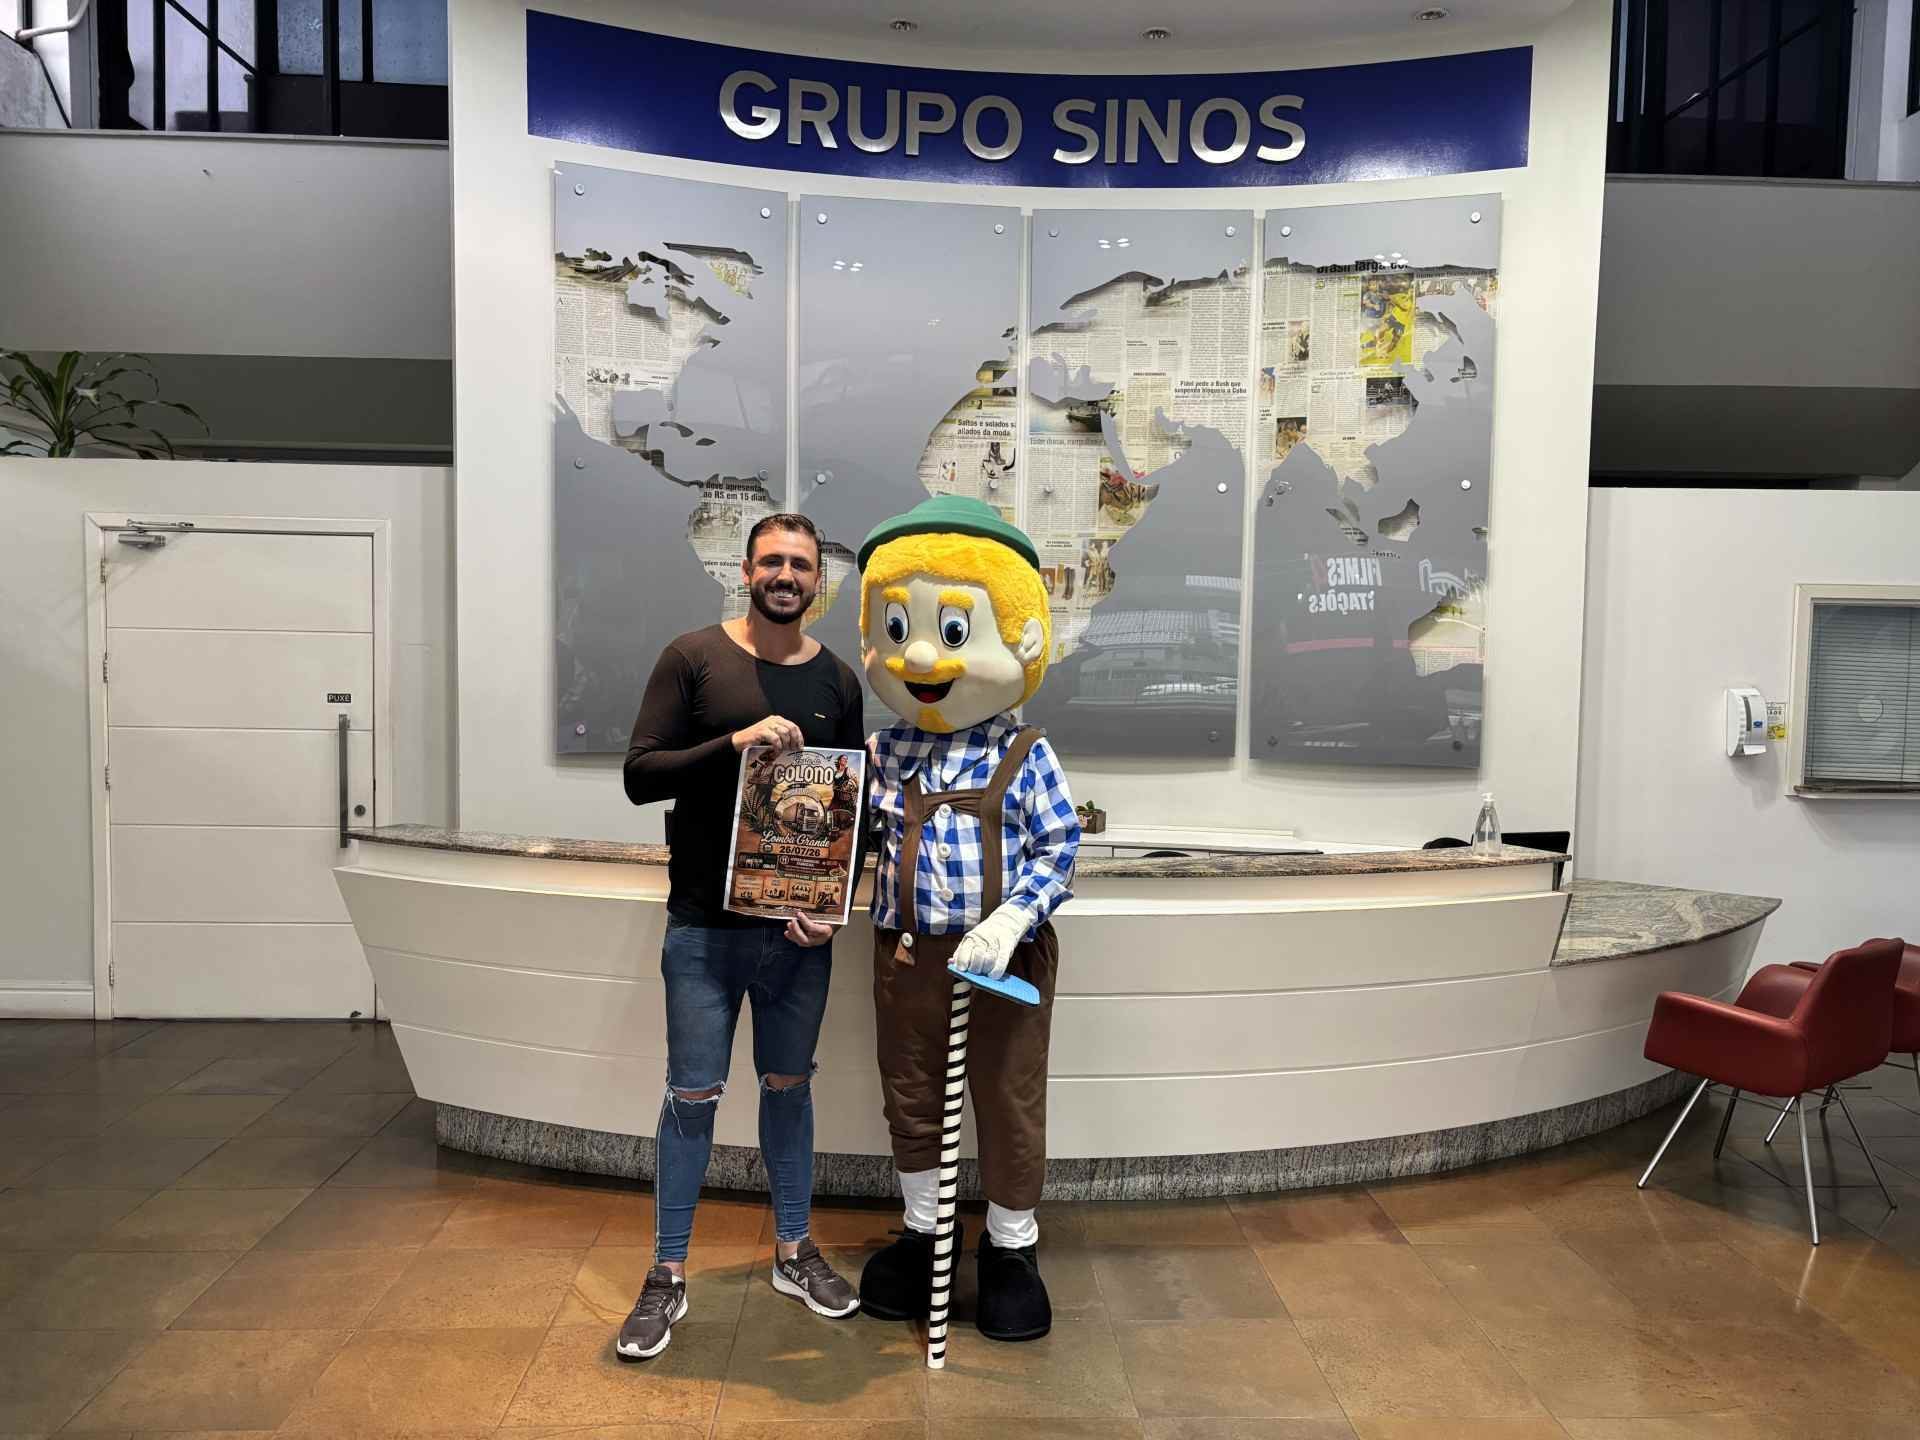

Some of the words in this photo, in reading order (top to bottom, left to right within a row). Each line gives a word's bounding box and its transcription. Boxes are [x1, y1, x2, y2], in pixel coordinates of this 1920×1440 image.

[719, 70, 1022, 160] GRUPO
[1052, 94, 1305, 164] SINOS
[714, 490, 725, 499] RS
[726, 492, 737, 500] em
[740, 491, 749, 501] 15
[328, 694, 351, 702] PUXE
[761, 830, 794, 844] Lomba
[796, 833, 830, 848] Grande
[783, 1263, 809, 1291] FILA
